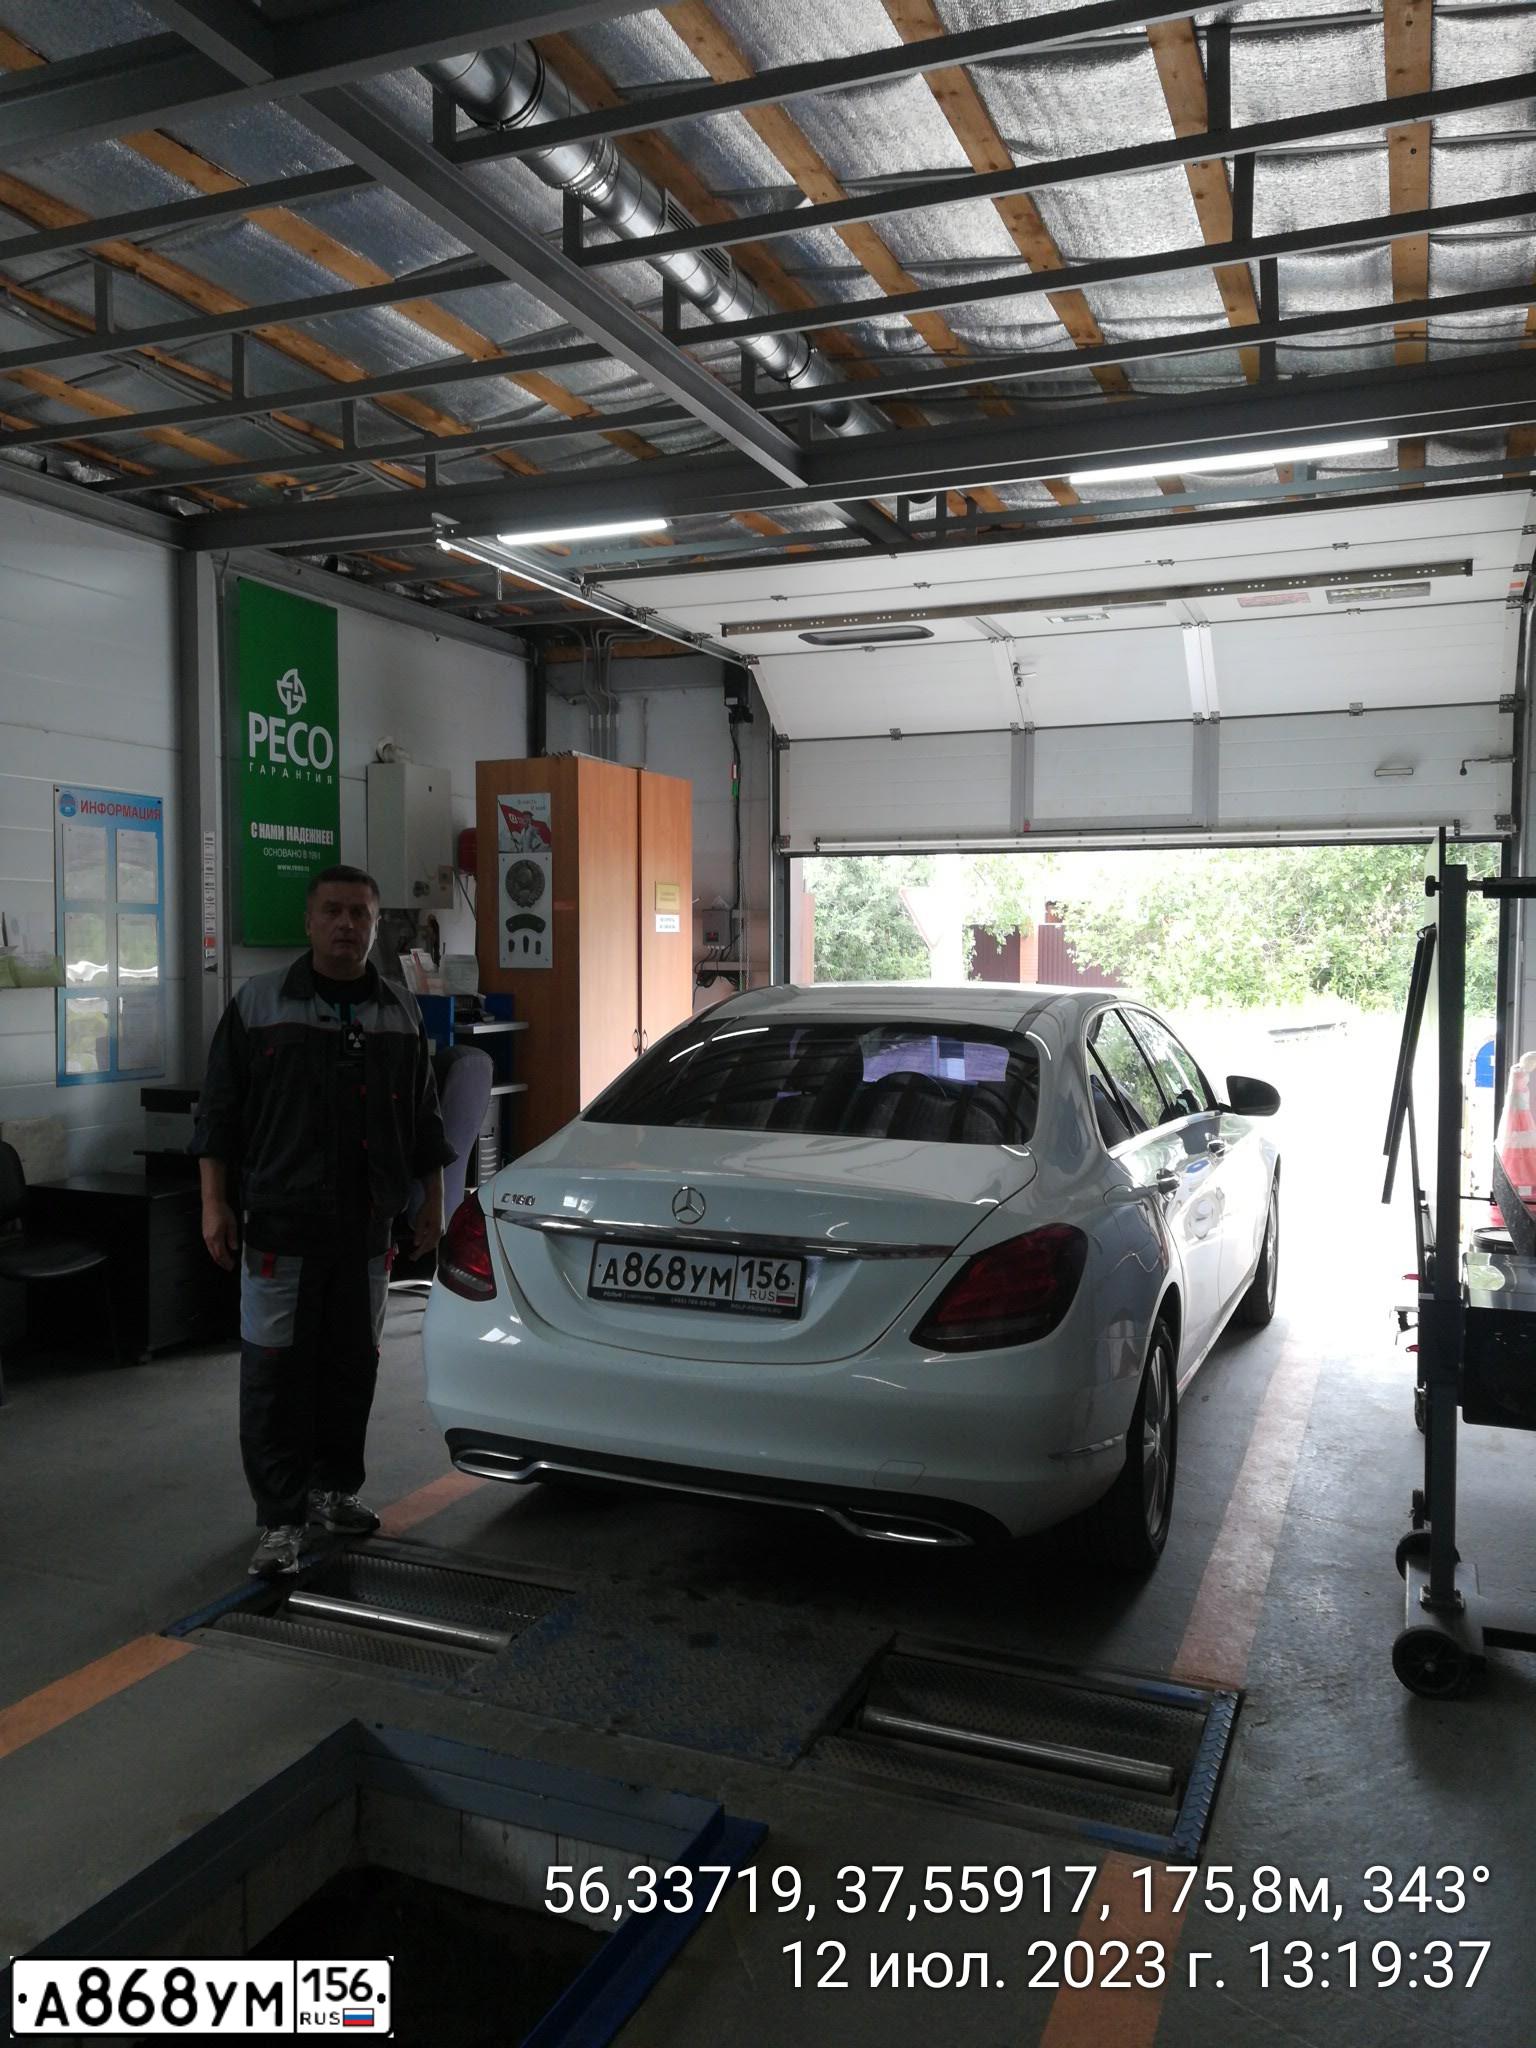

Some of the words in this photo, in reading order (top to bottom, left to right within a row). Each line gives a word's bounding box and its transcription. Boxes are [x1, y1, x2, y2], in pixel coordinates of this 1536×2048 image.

[248, 711, 334, 770] РЕСО
[249, 761, 332, 784] ГАРАНТИЯ
[80, 799, 161, 821] ИНФОРМАЦИЯ
[250, 821, 257, 839] С
[258, 822, 285, 841] НАМИ
[286, 825, 334, 846] НАДЕЖНЕЕ!
[263, 847, 302, 859] ОСНОВАНО
[601, 1252, 733, 1297] А868УМ
[741, 1260, 791, 1291] 156
[749, 1289, 776, 1302] RUS
